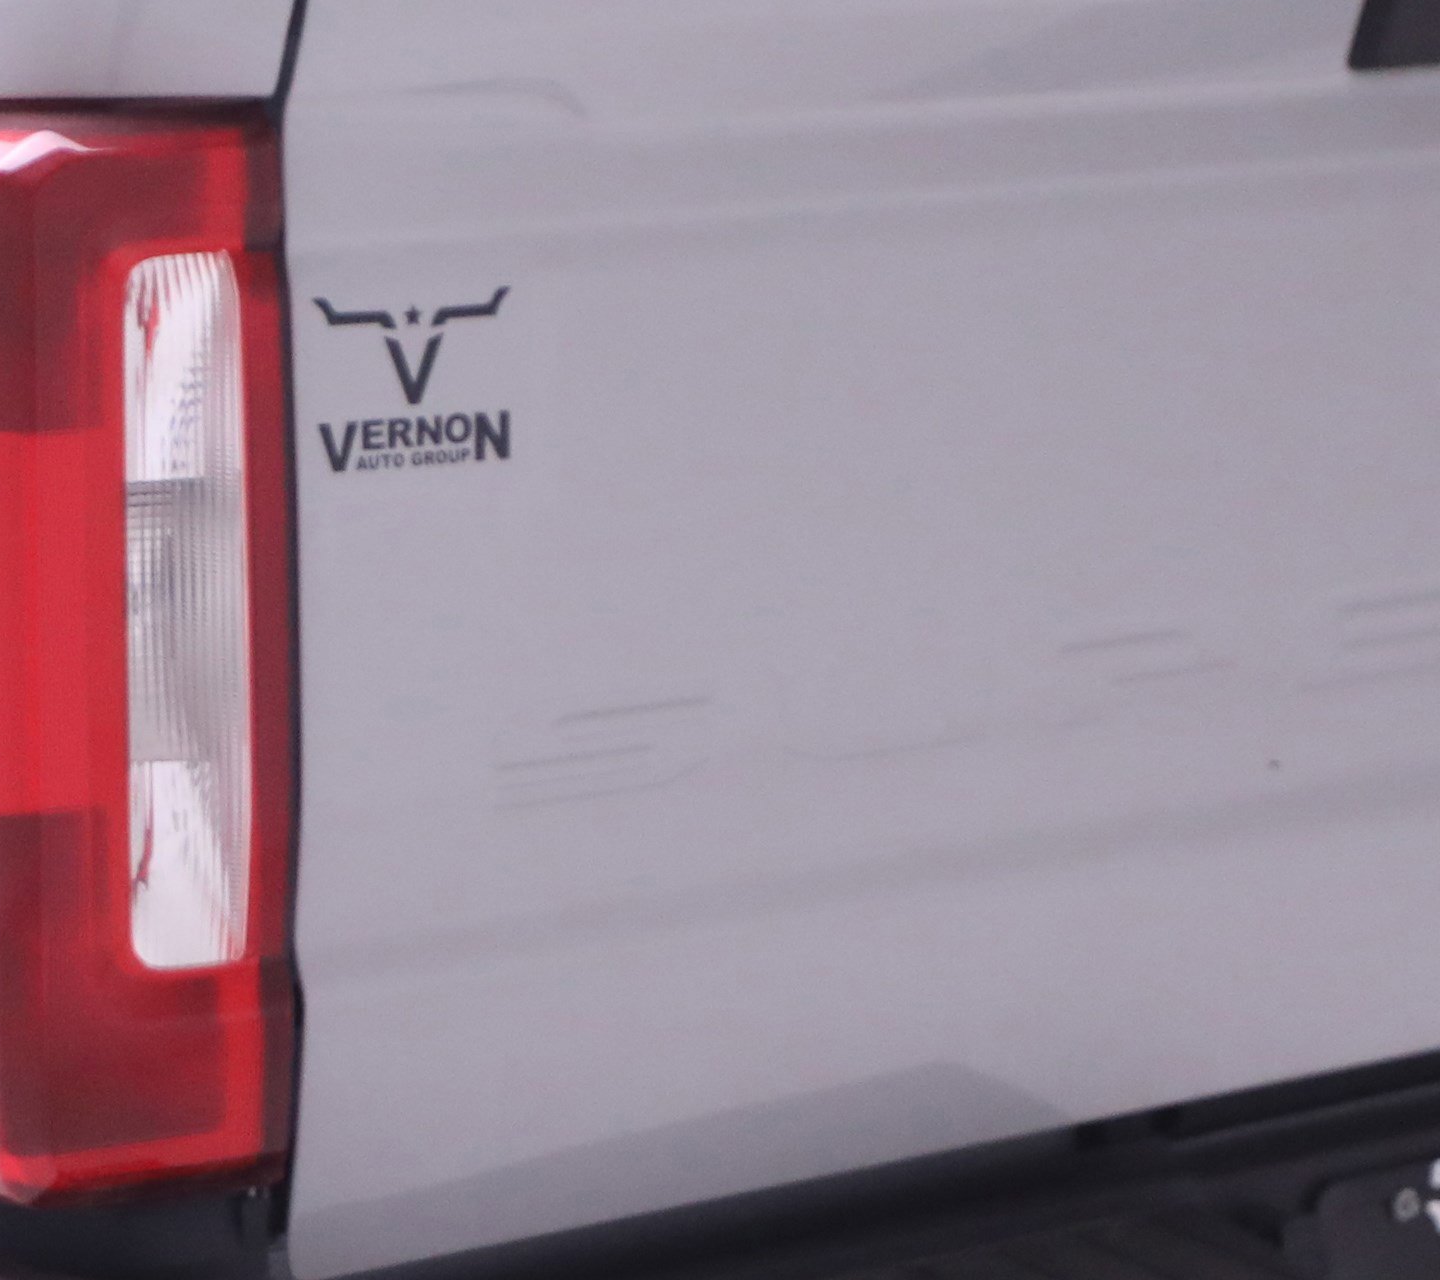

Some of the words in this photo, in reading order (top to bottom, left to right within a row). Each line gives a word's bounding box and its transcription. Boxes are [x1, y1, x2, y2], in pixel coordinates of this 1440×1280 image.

[318, 409, 511, 472] VERNON
[355, 452, 406, 471] AUTO
[412, 447, 471, 467] GROUP
